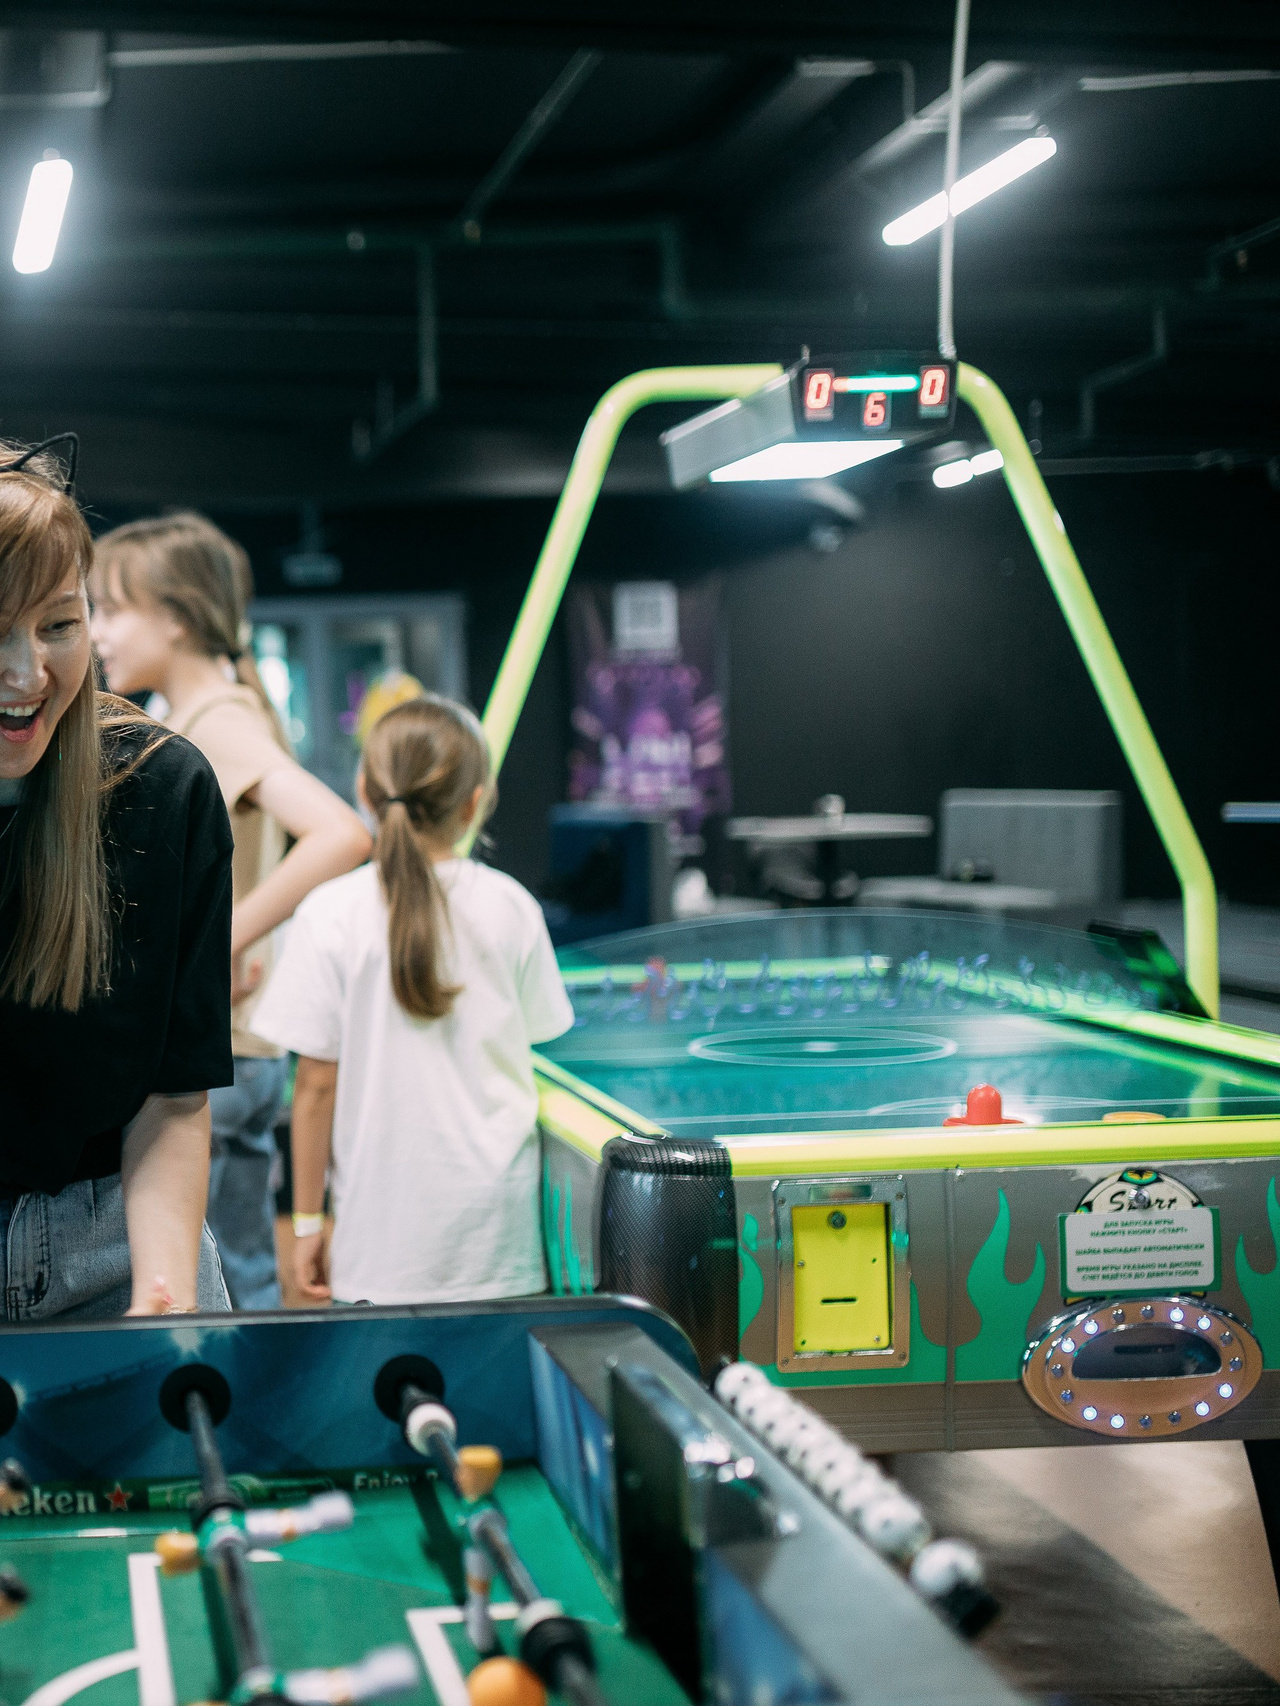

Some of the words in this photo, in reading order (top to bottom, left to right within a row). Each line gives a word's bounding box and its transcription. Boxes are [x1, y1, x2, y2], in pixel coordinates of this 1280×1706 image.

[806, 373, 832, 410] 0
[920, 369, 946, 406] 0
[863, 392, 887, 427] 6
